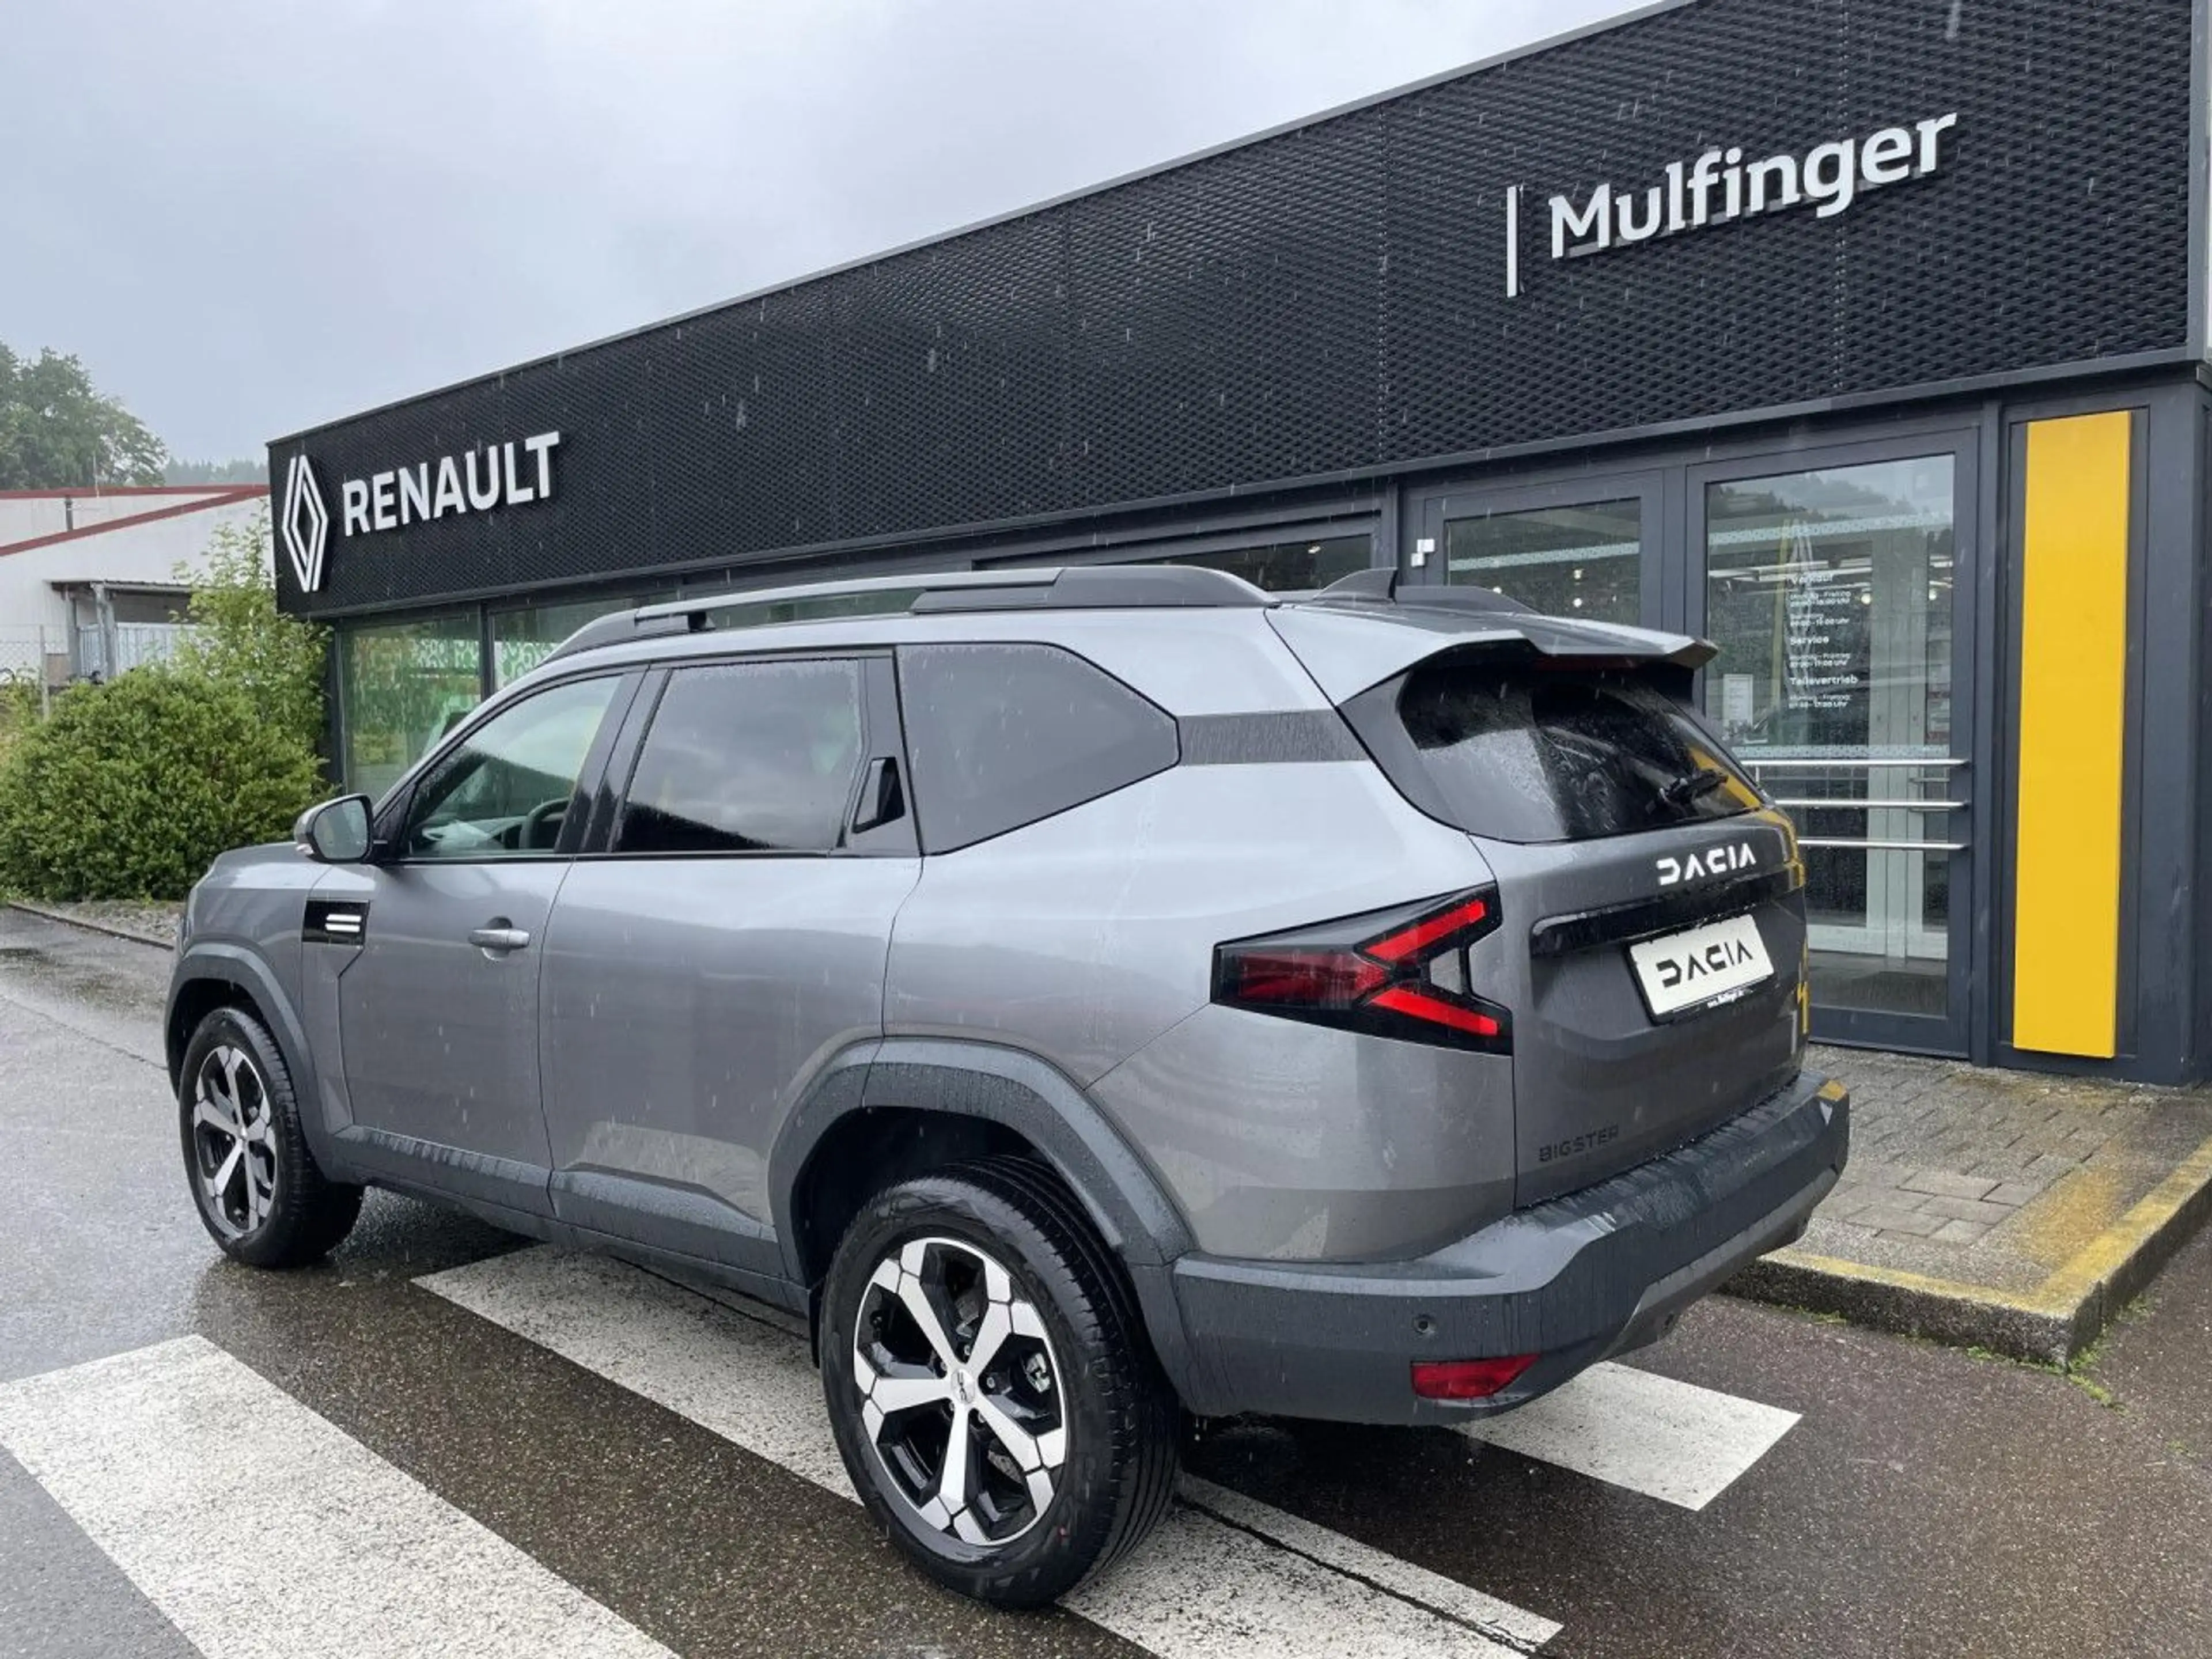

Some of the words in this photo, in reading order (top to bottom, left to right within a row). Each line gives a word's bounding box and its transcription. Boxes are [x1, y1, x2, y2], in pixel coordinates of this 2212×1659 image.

[1548, 113, 1957, 259] Mulfinger
[342, 431, 559, 536] RENAULT
[1790, 636, 1829, 645] Service
[1656, 843, 1756, 885] DACIA
[1656, 939, 1753, 988] DACIA
[1539, 1124, 1619, 1162] BIGSTER
